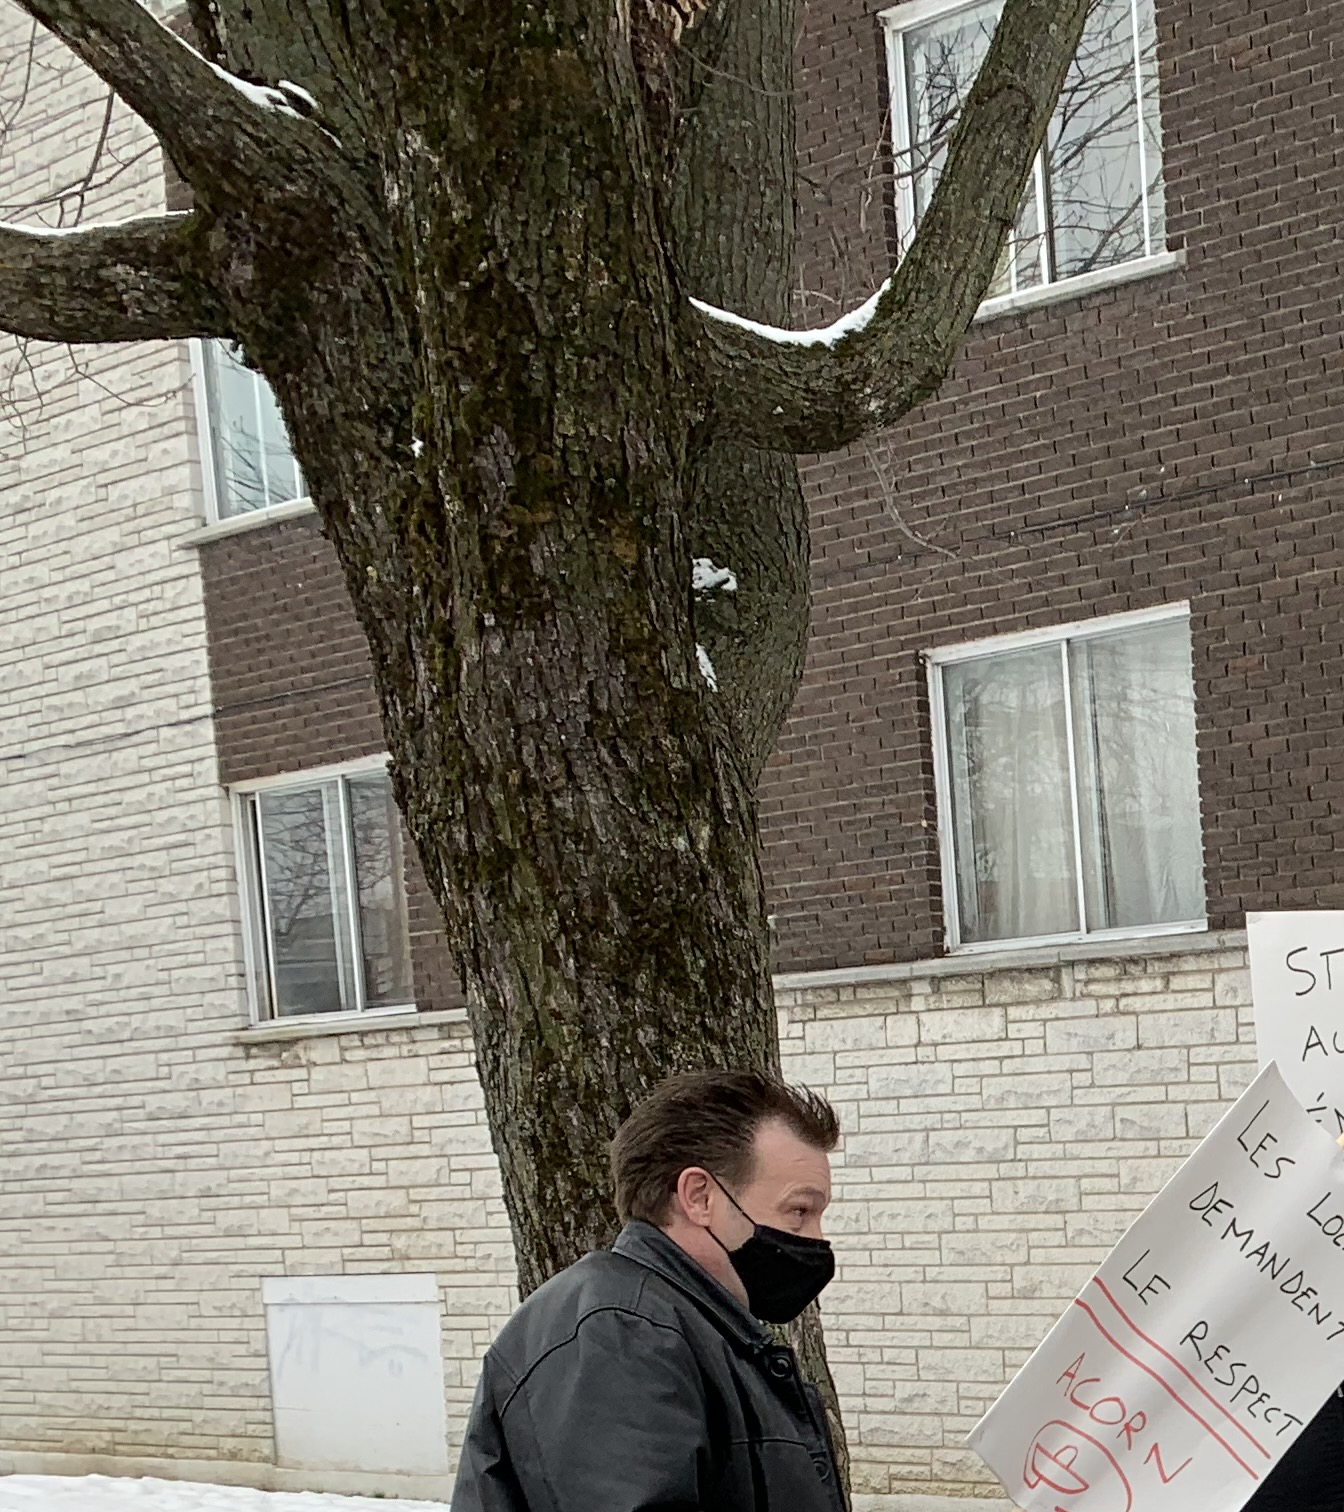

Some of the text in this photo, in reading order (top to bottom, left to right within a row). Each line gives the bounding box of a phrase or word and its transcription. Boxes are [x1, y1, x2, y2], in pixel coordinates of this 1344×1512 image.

[1236, 1099, 1297, 1180] LES
[1120, 1248, 1305, 1438] LE RESPECT
